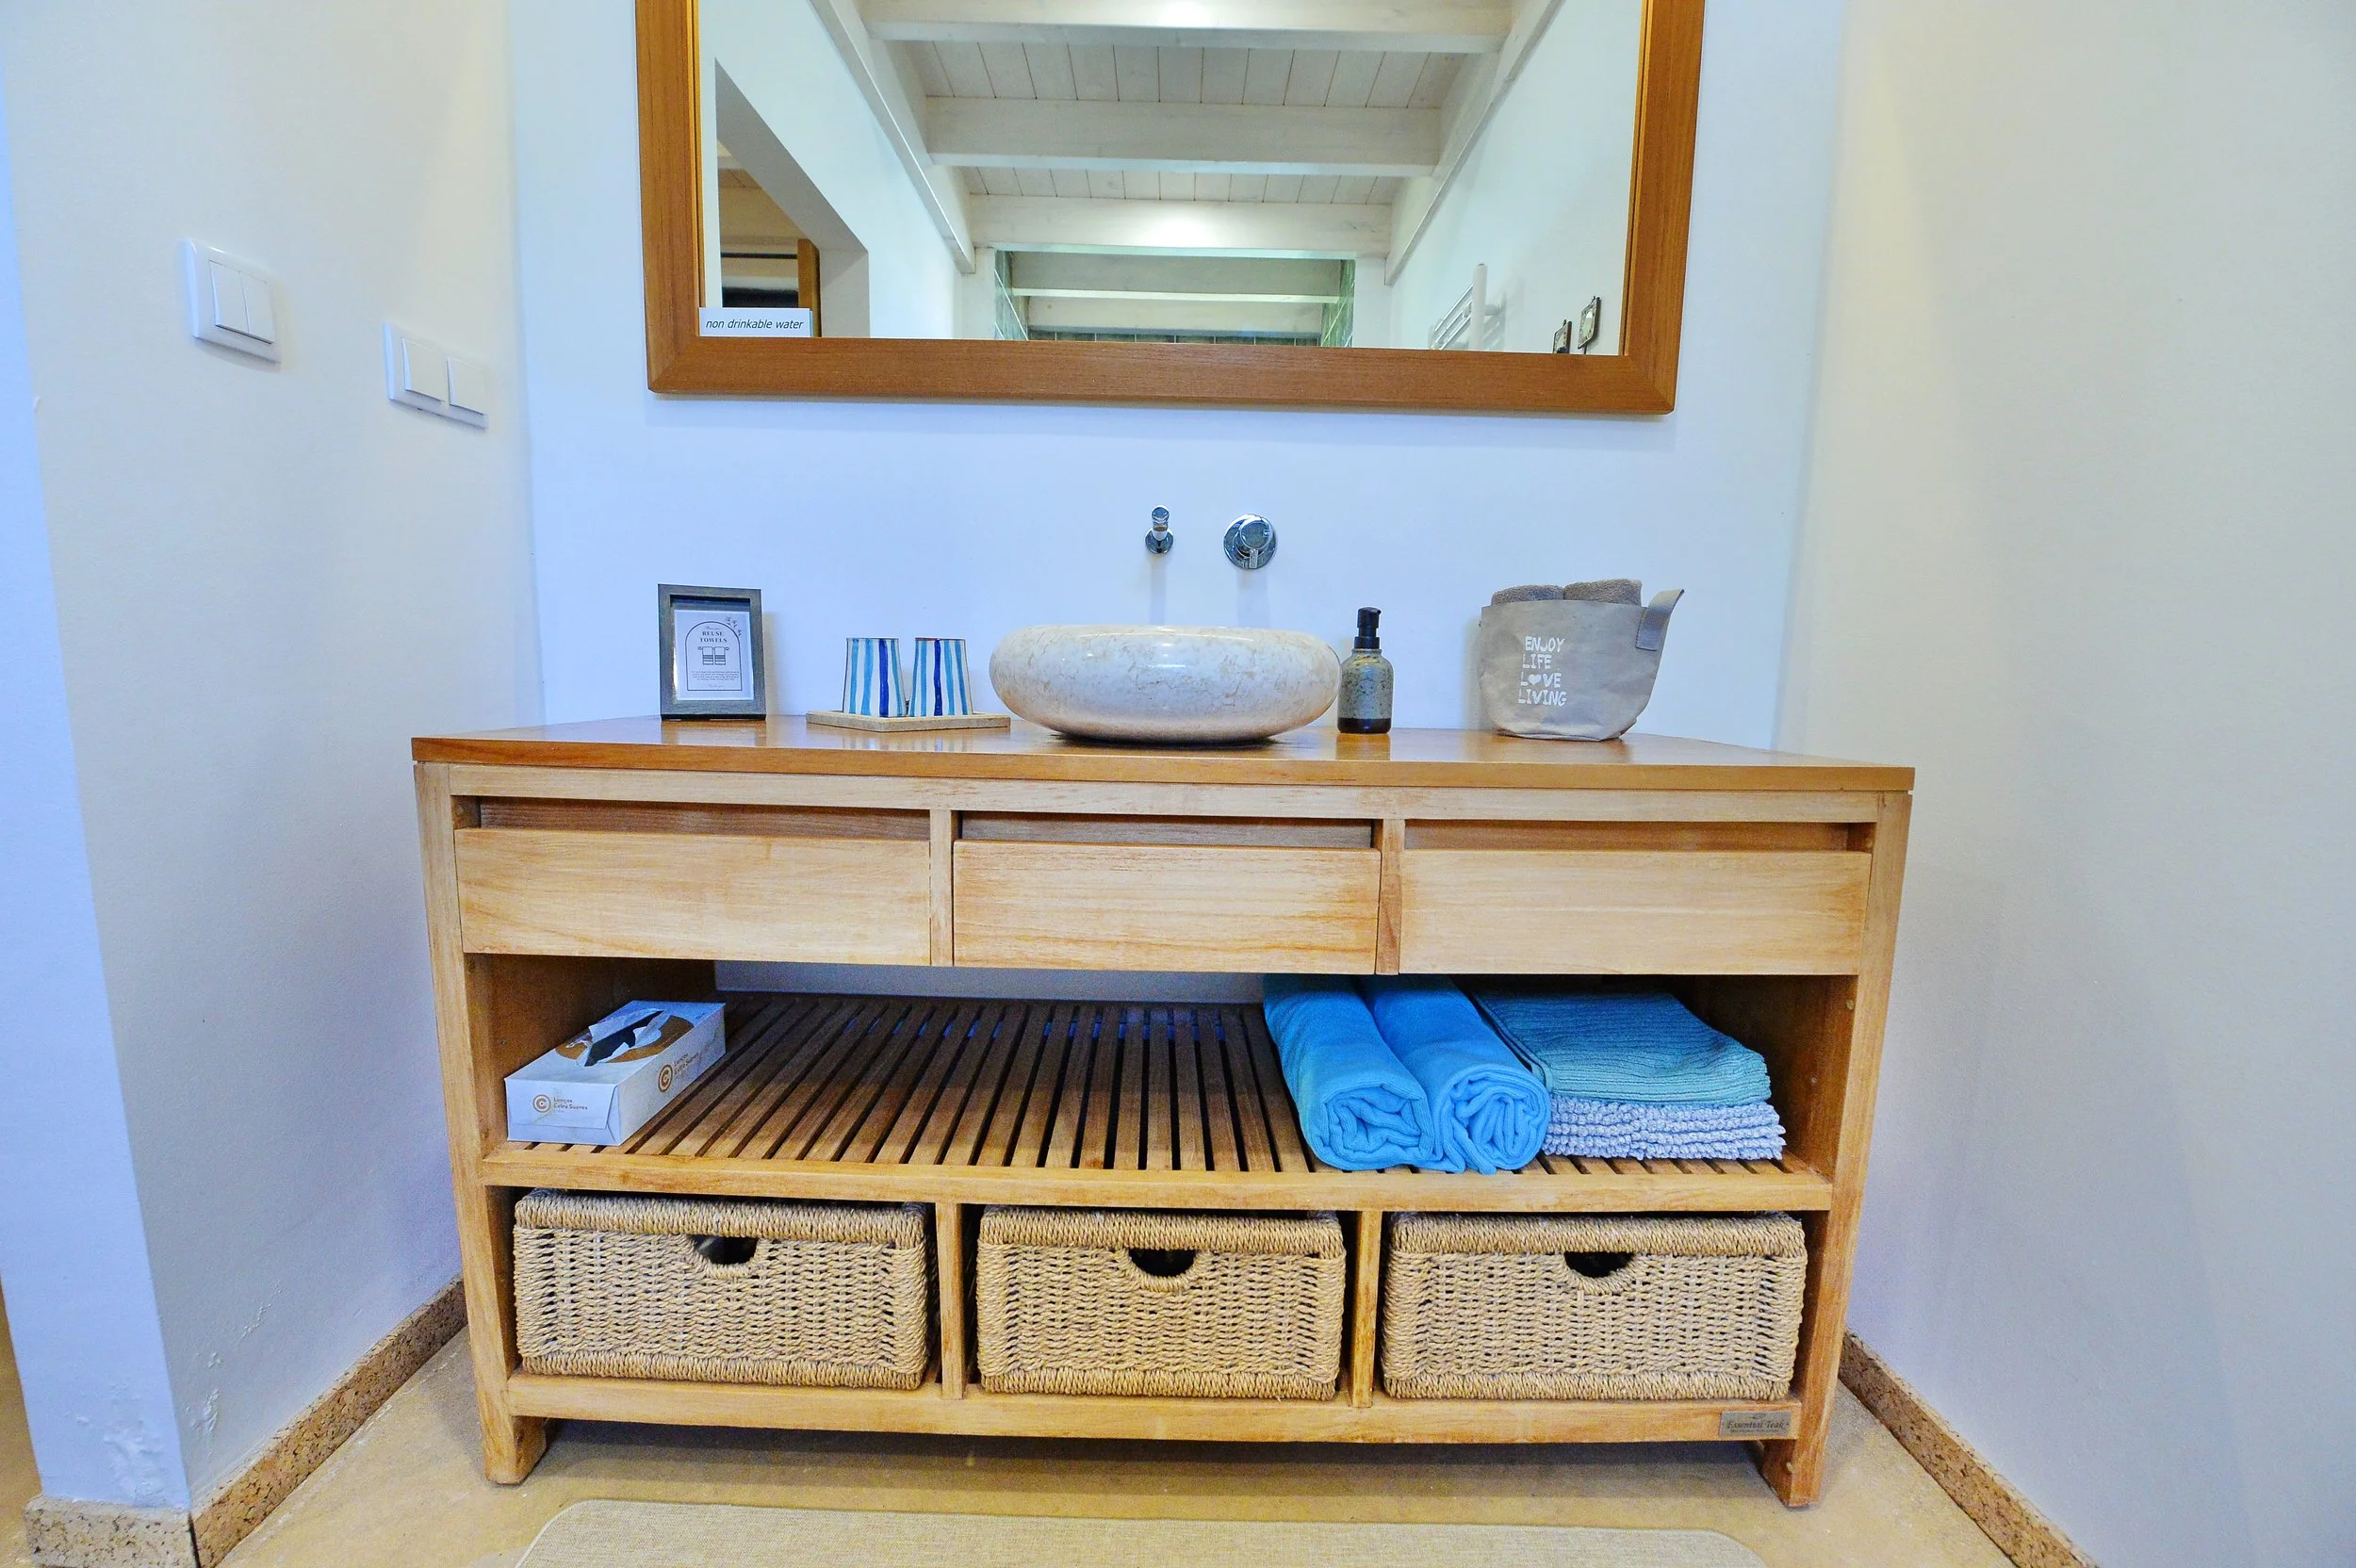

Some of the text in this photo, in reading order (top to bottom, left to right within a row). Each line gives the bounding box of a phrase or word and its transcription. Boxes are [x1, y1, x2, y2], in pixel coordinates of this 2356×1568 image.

[706, 318, 804, 329] non drinkable water
[1525, 635, 1565, 652] ENJOY
[1522, 653, 1552, 669] LIFE
[1517, 688, 1567, 707] LIVING
[1726, 1419, 1784, 1429] Essential Teak
